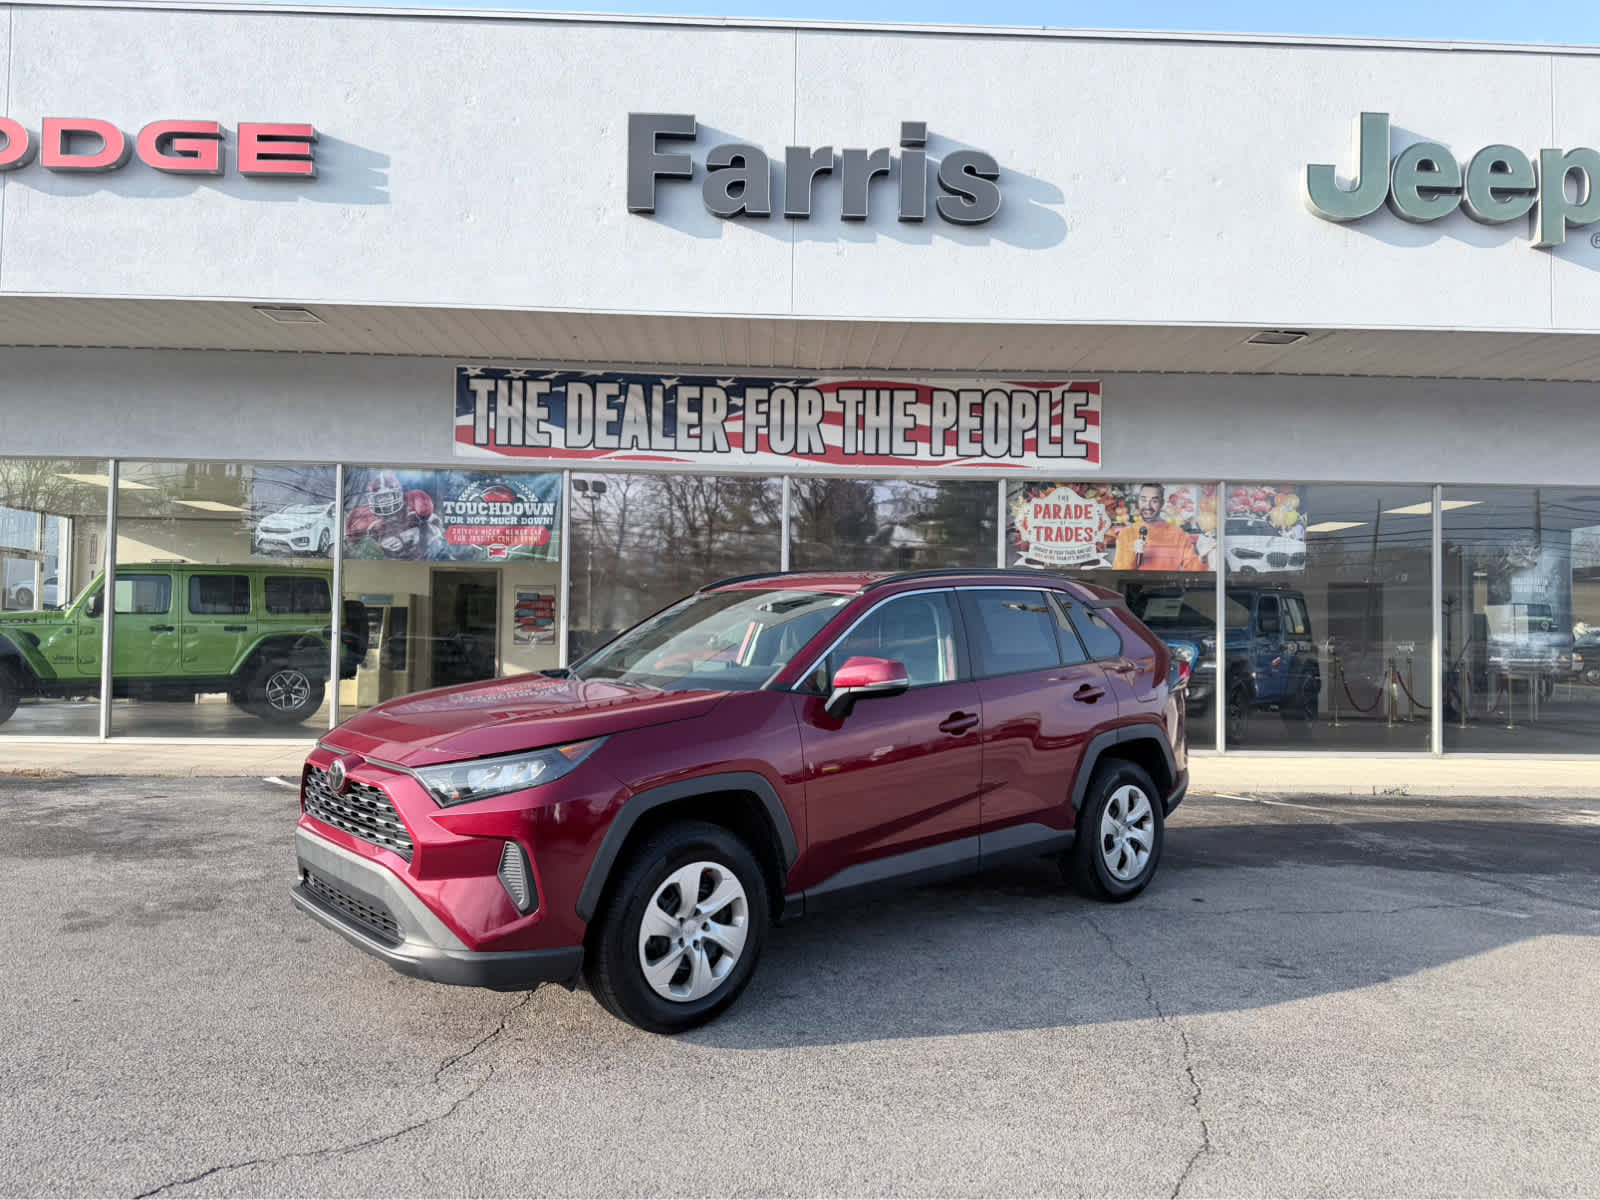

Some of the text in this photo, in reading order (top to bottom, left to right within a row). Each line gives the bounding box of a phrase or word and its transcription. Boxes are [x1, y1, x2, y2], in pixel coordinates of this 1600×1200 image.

[627, 112, 1001, 225] Farris
[1304, 111, 1600, 249] Jeep
[468, 377, 1089, 459] THE DEALER FOR THE PEOPLE
[443, 502, 555, 515] TOUCHDOWN
[1033, 503, 1094, 520] PARADE
[443, 515, 554, 526] FOR NOT MUCH DOWN!
[1032, 526, 1094, 543] TRADES
